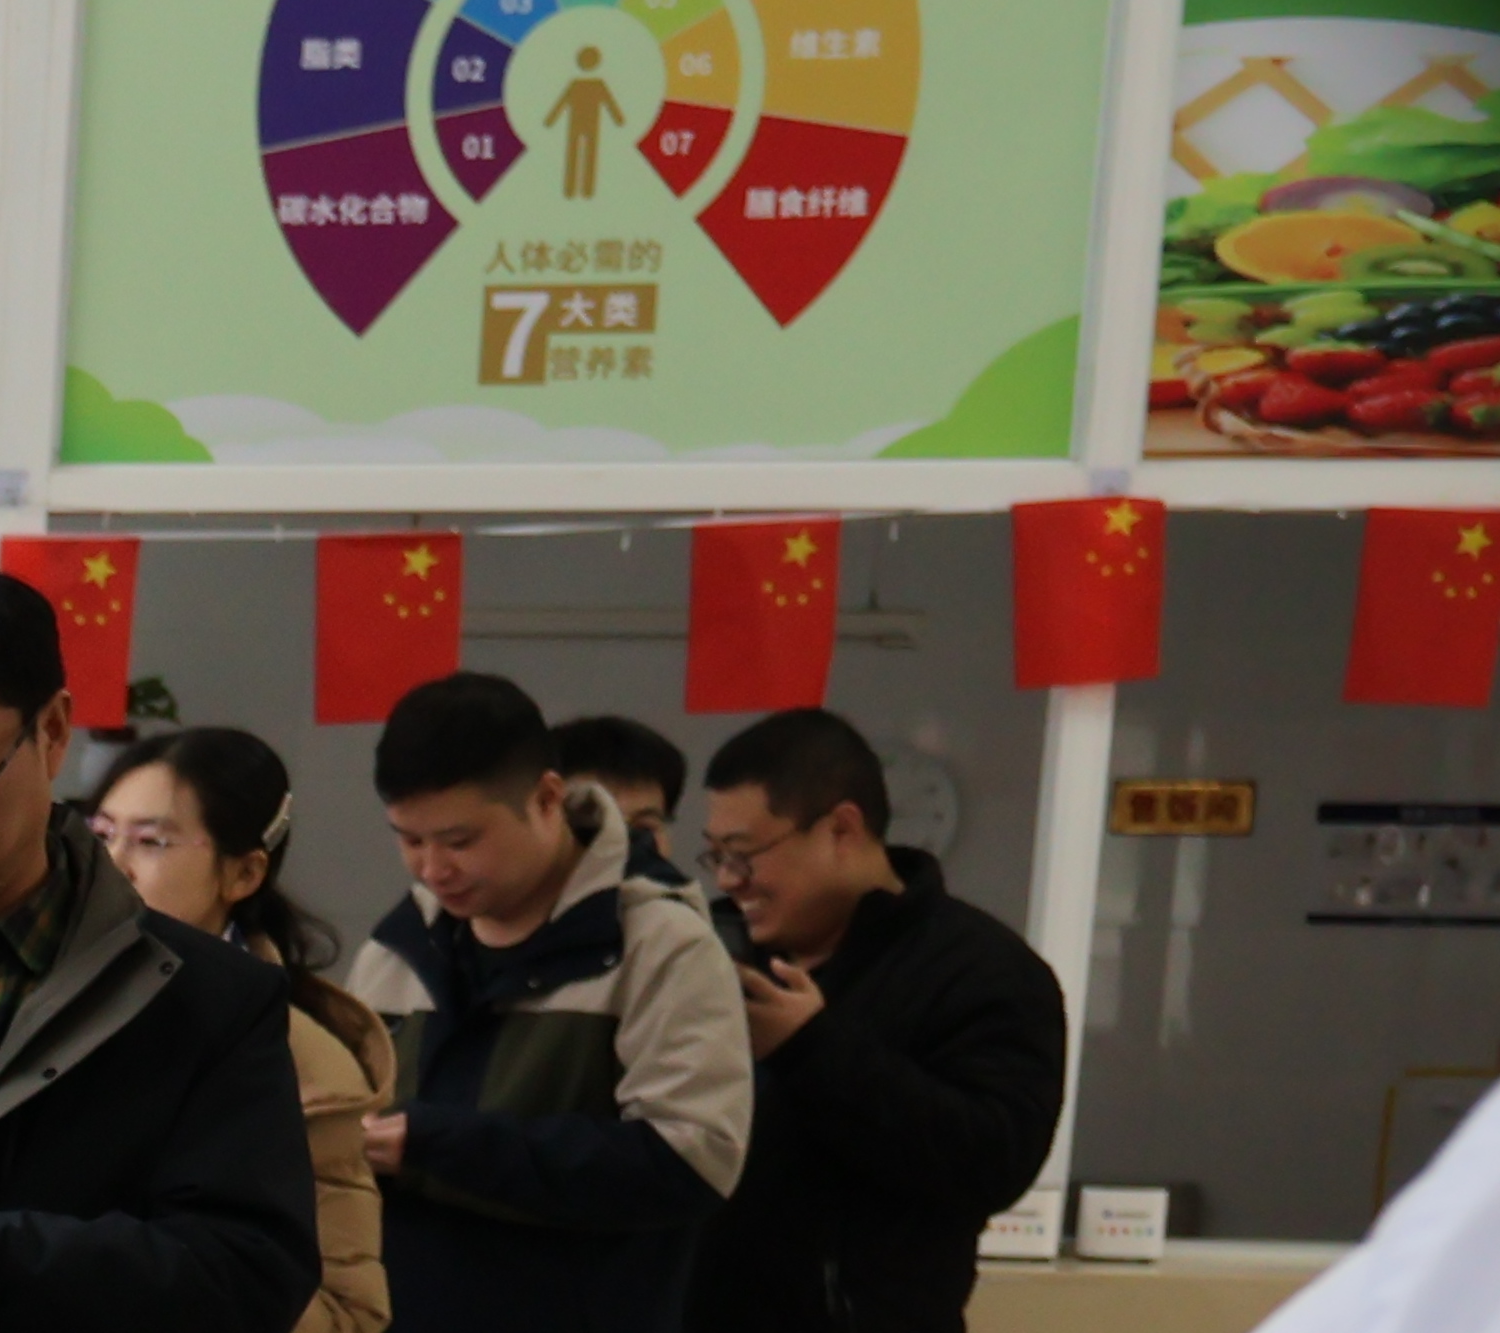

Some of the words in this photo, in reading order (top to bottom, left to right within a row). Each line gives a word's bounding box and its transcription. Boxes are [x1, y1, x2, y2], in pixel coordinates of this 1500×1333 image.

[301, 38, 362, 70] 脂类
[791, 29, 881, 60] 维生素
[451, 56, 488, 83] 02
[679, 52, 713, 77] 06
[462, 135, 497, 160] 01
[660, 129, 696, 156] 07
[278, 193, 430, 225] 碳水化合物
[745, 186, 869, 220] 膳食纤维
[485, 239, 663, 274] 人体必需的
[491, 291, 550, 378] 7
[561, 291, 637, 327] 大类
[551, 346, 653, 380] 营养素
